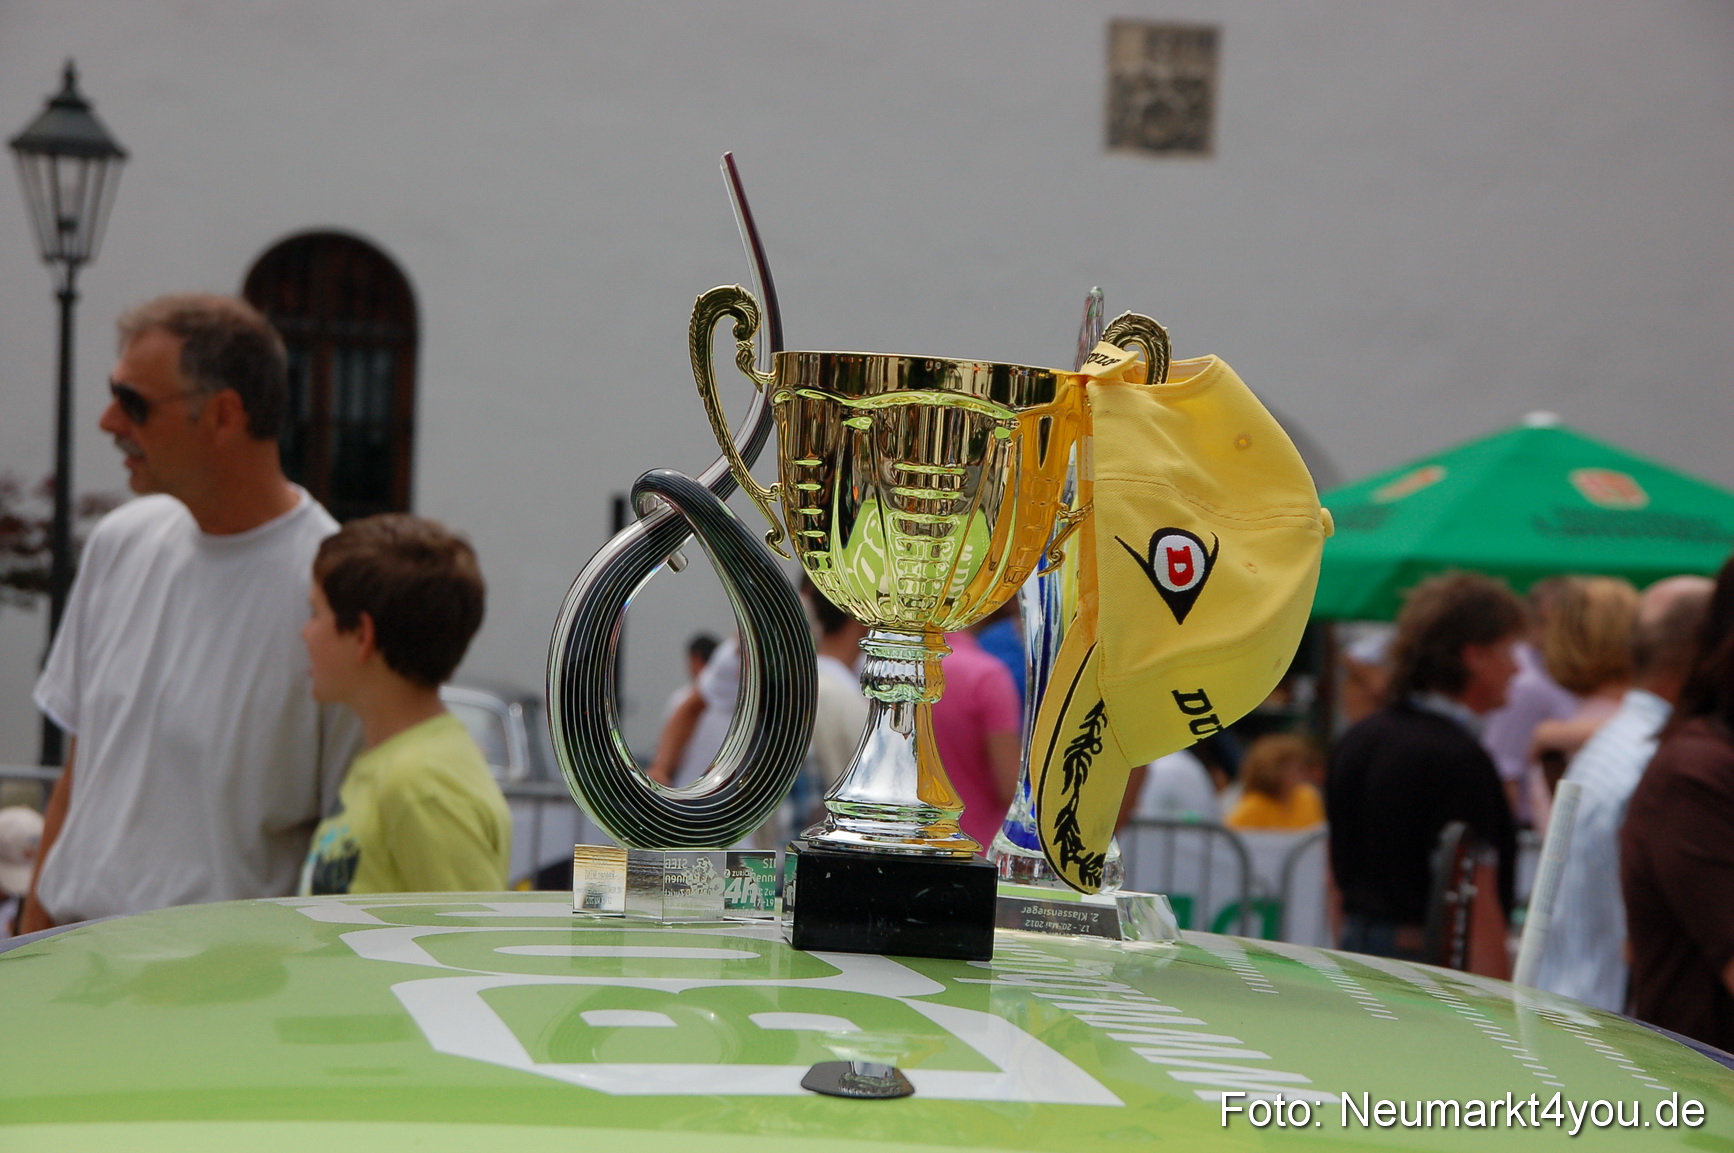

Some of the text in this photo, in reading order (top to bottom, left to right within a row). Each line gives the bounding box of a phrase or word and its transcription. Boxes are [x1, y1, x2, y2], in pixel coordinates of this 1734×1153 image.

[1171, 688, 1223, 742] DU
[1021, 905, 1100, 923] 2. Klassensieger
[1025, 919, 1044, 928] 2012
